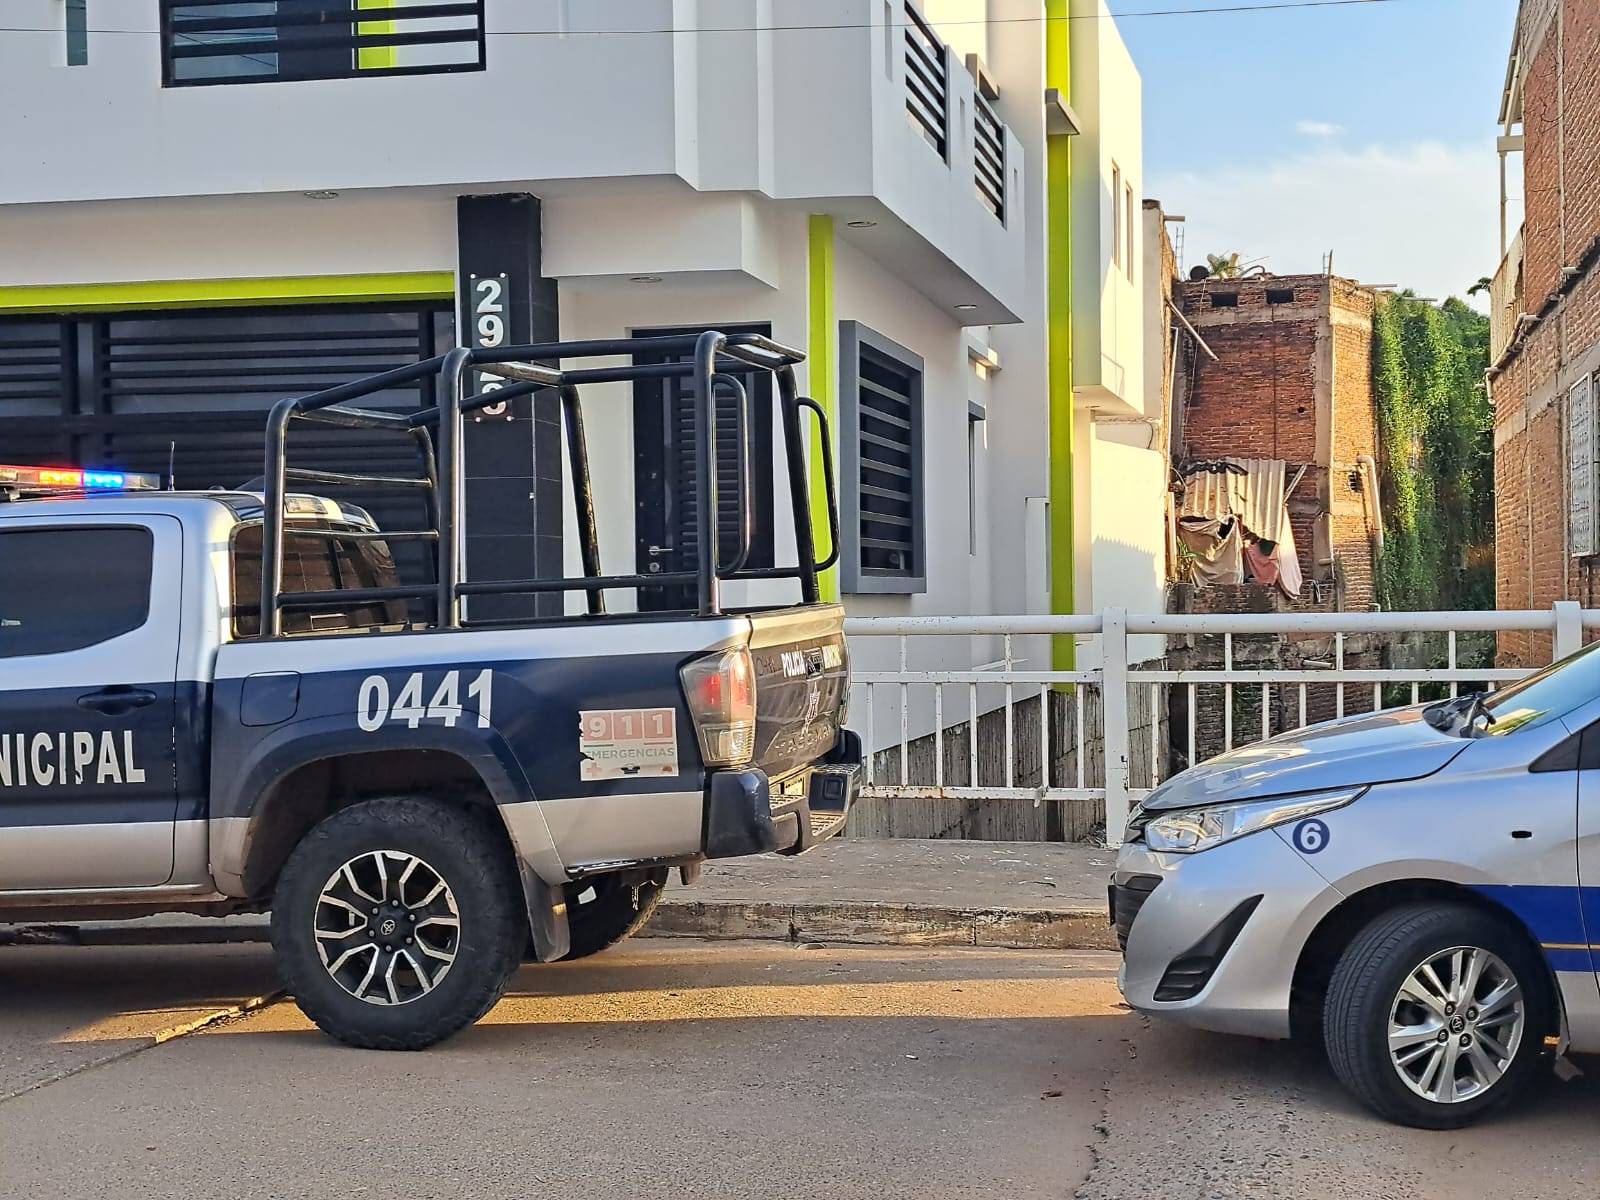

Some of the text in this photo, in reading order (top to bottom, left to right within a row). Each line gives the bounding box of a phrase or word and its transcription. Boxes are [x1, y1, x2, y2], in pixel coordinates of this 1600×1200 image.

[357, 668, 493, 732] 0441
[589, 713, 664, 738] 911
[1301, 822, 1322, 850] 6
